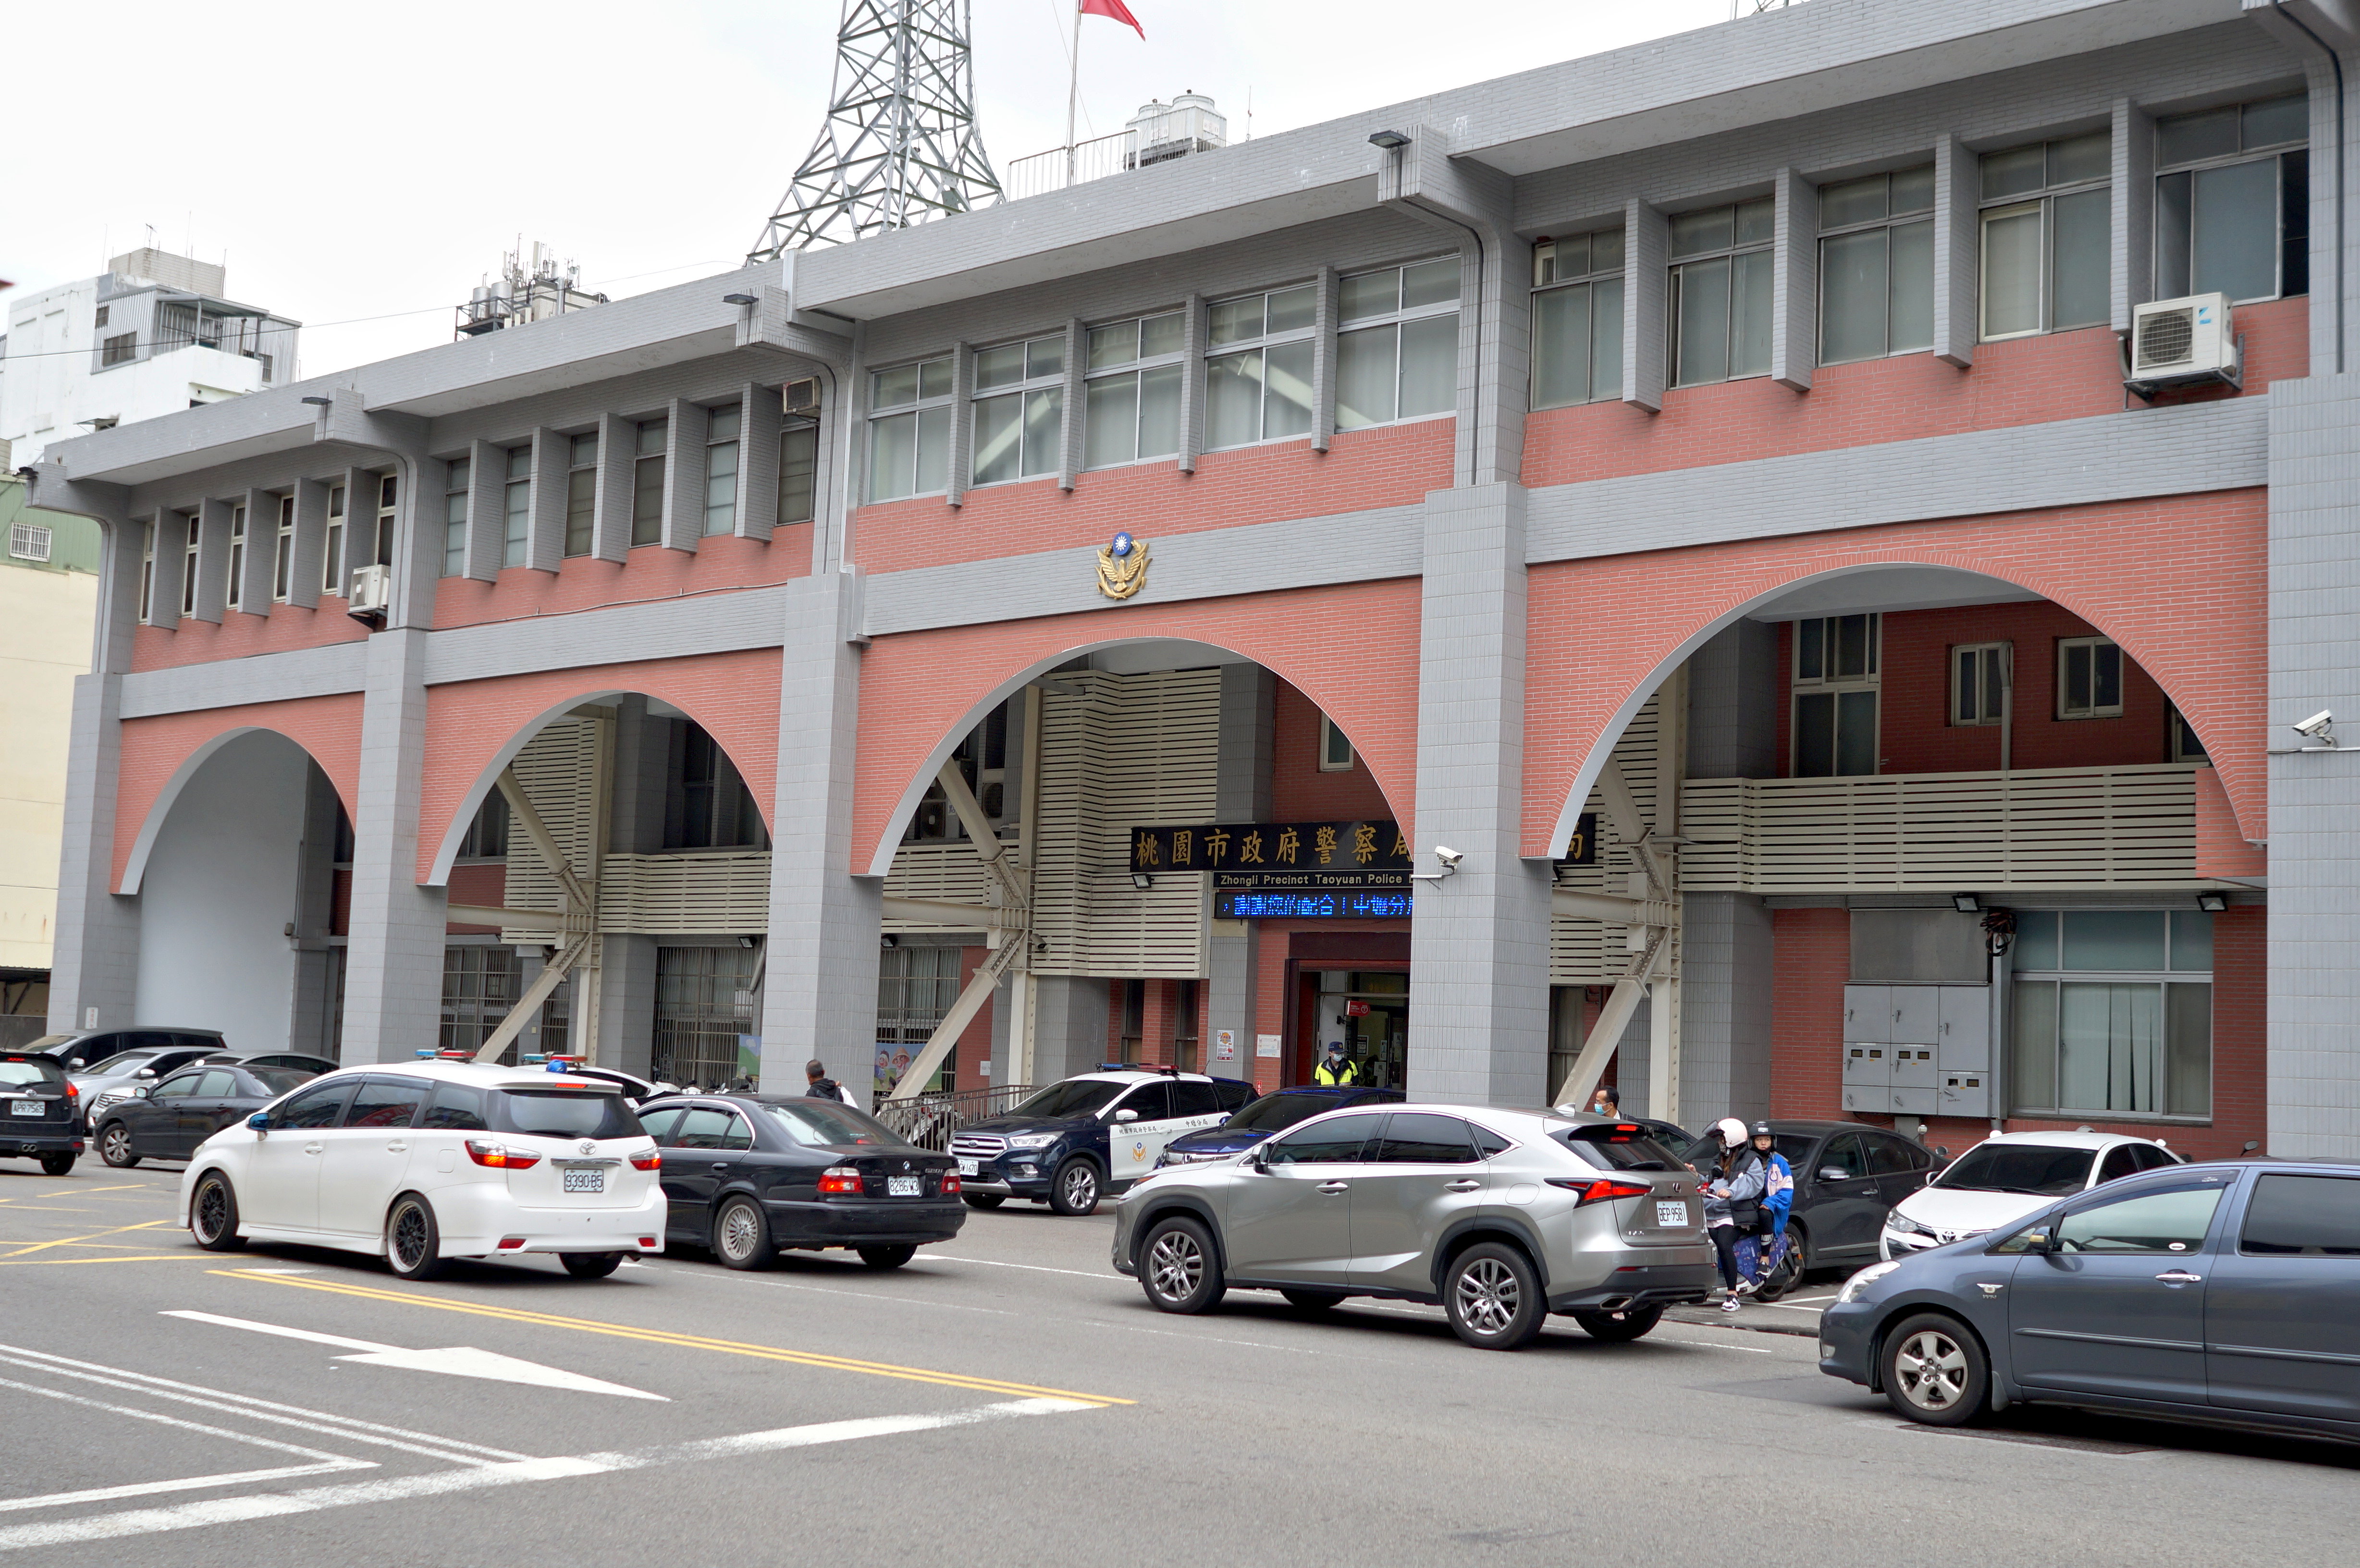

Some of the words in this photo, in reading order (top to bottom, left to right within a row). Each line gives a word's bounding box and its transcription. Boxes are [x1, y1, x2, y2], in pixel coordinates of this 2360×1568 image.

[1136, 824, 1412, 867] 桃園市政府警察局
[1221, 875, 1258, 886] Zhongli
[1264, 875, 1308, 884] Precinct
[1315, 874, 1362, 885] Taoyuan
[1368, 873, 1402, 883] Police
[565, 1175, 602, 1188] 9390-B5
